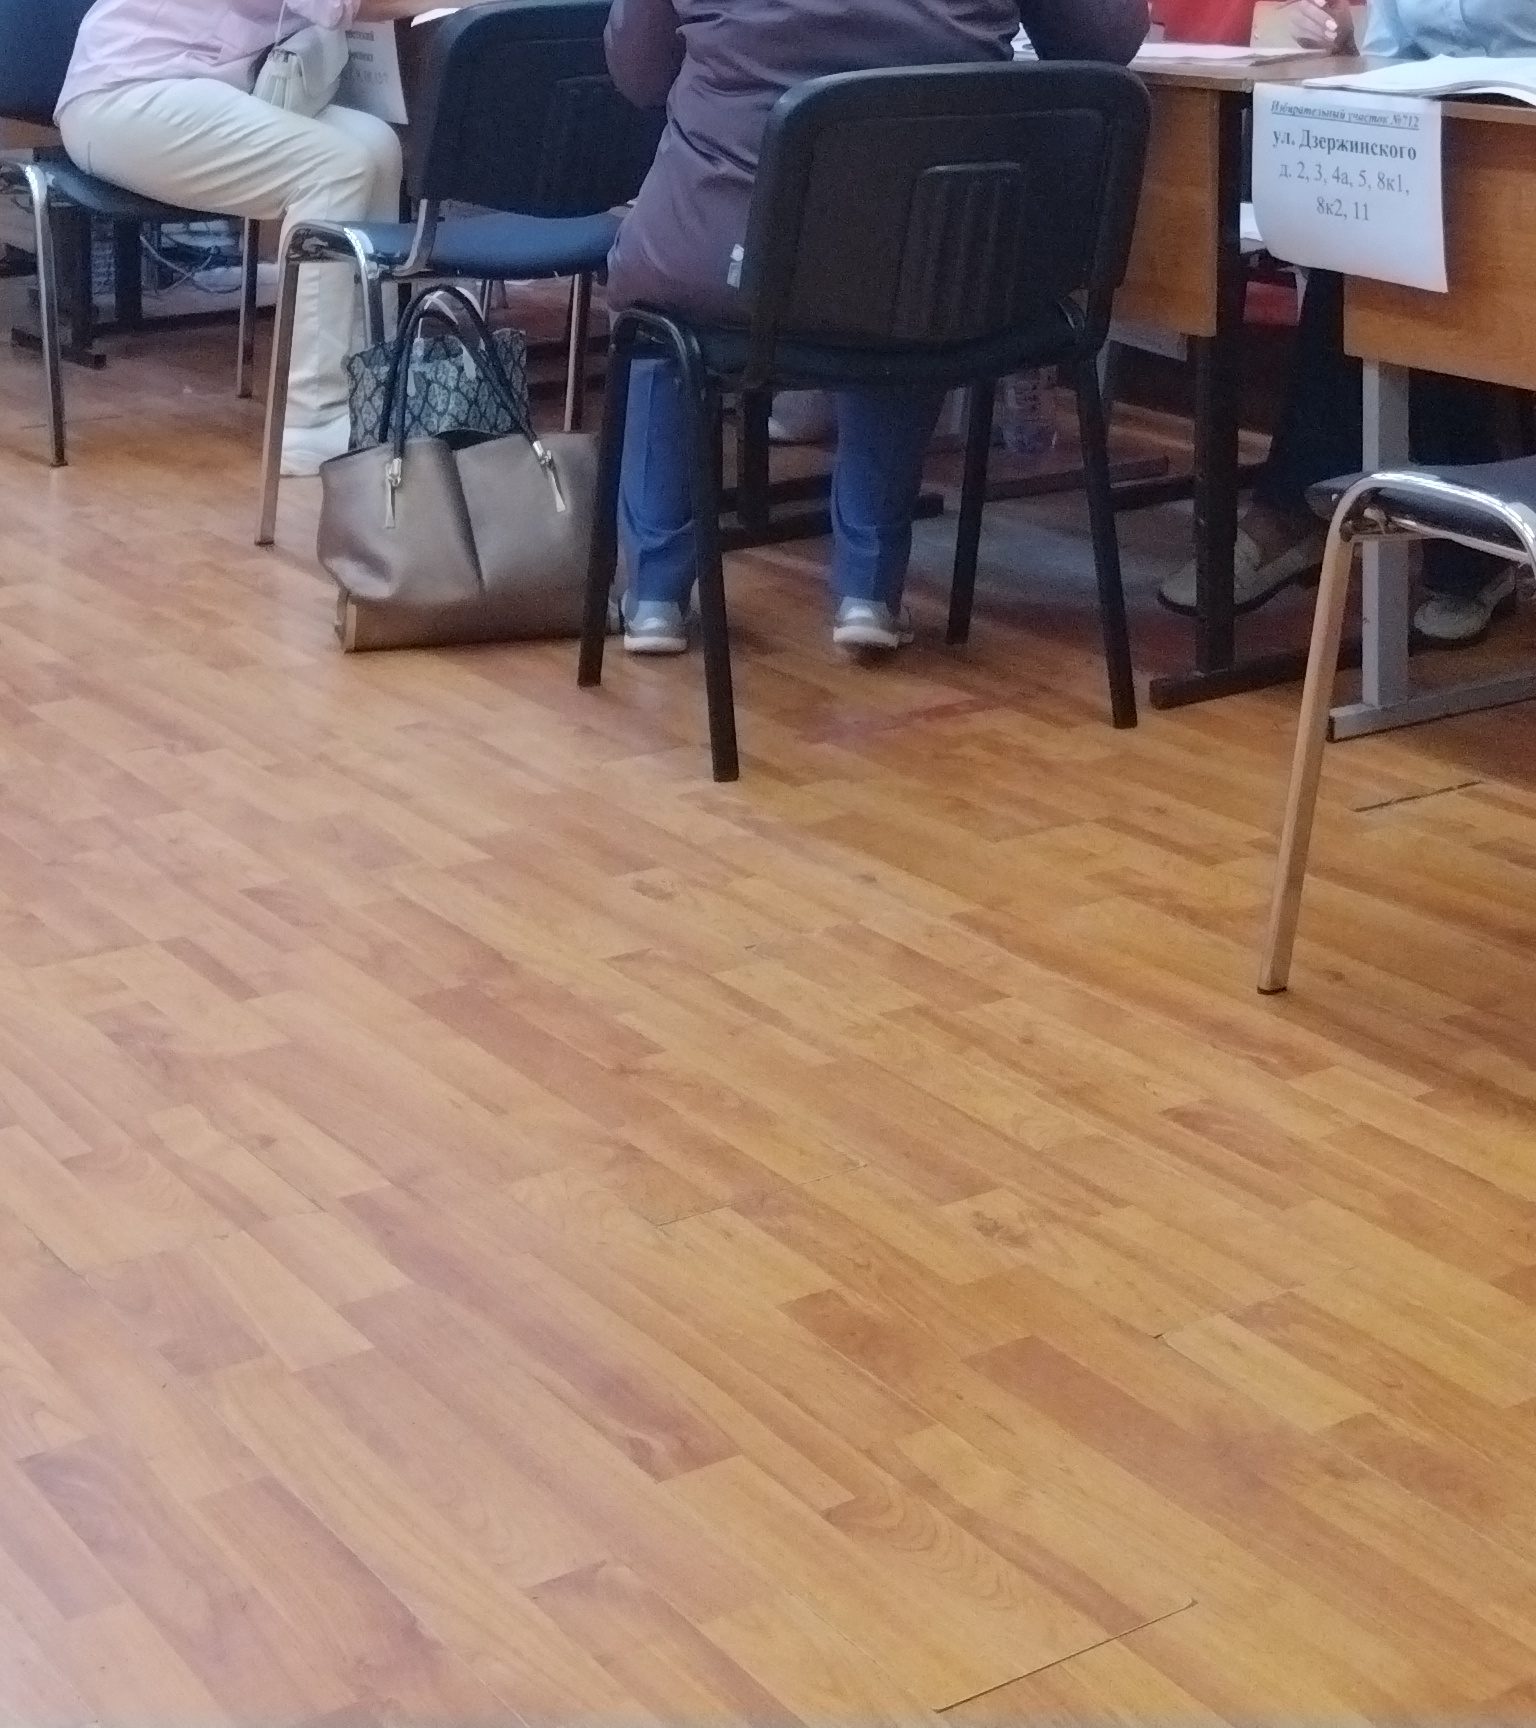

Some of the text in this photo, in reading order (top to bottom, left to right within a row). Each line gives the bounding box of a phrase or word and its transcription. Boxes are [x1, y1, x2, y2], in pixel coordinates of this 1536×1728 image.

[1272, 129, 1417, 161] ул. Дзержинского
[1279, 161, 1410, 196] д. 2, 3, 4а, 5, 8к1,
[1316, 196, 1369, 221] 8к2, 11
